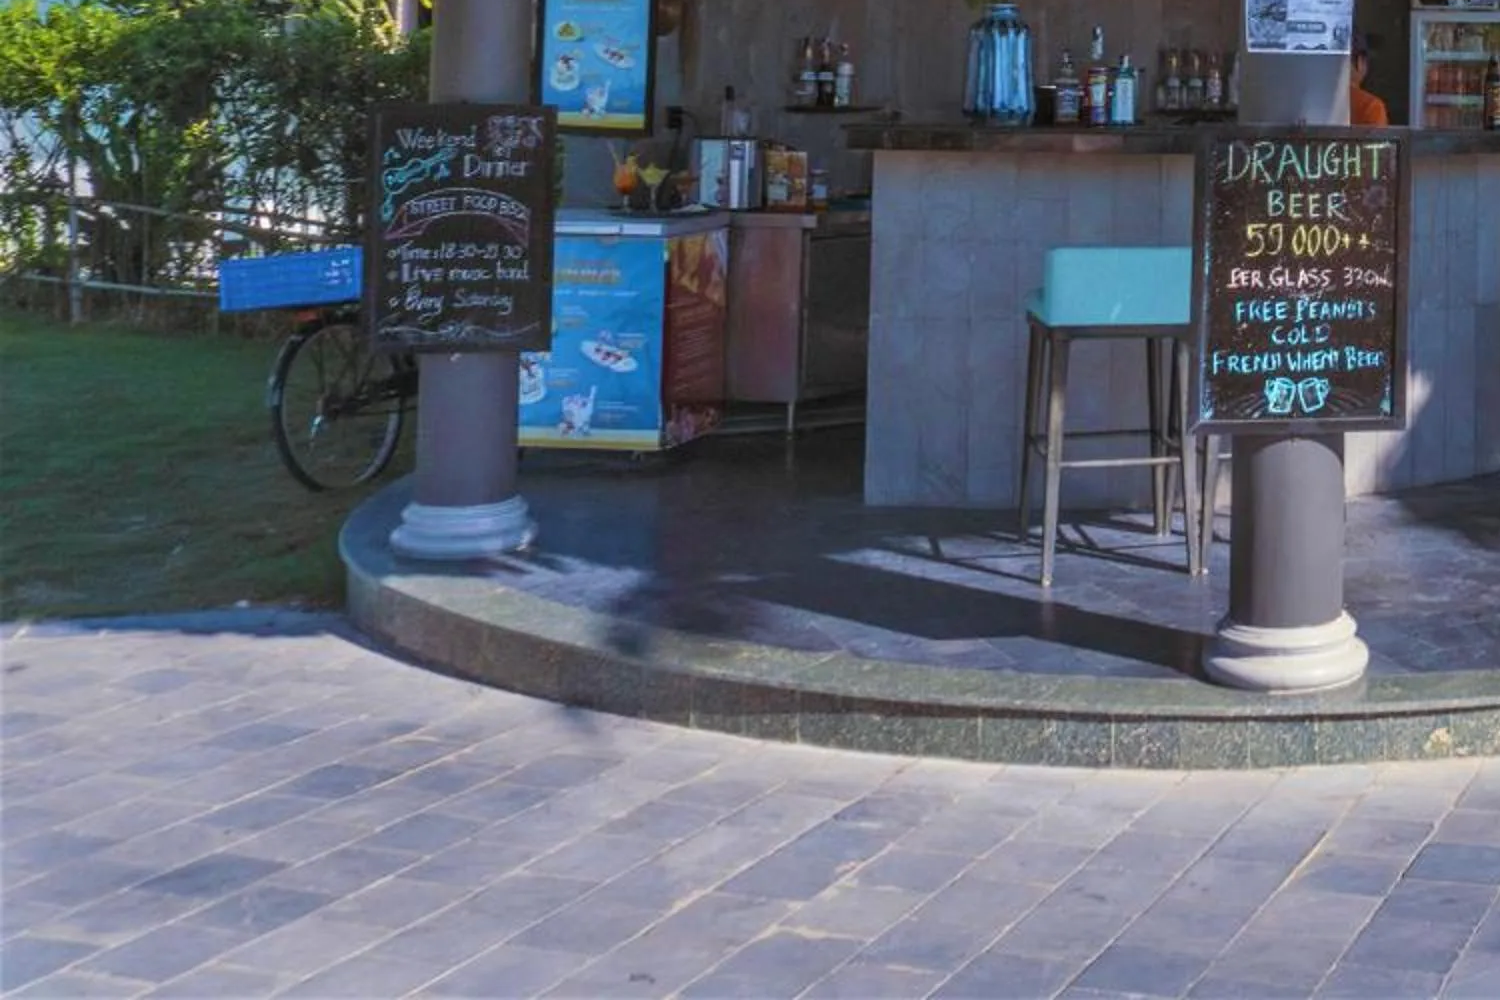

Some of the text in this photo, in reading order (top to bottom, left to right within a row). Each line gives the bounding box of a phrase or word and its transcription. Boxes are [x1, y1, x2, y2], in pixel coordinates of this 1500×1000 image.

[396, 124, 478, 149] Weekend
[1223, 141, 1391, 184] DRAUGHT
[1267, 189, 1351, 221] BEER
[1227, 267, 1264, 289] PER
[1269, 265, 1334, 289] GLASS
[1235, 300, 1289, 322] FREE
[1271, 324, 1331, 345] COLD
